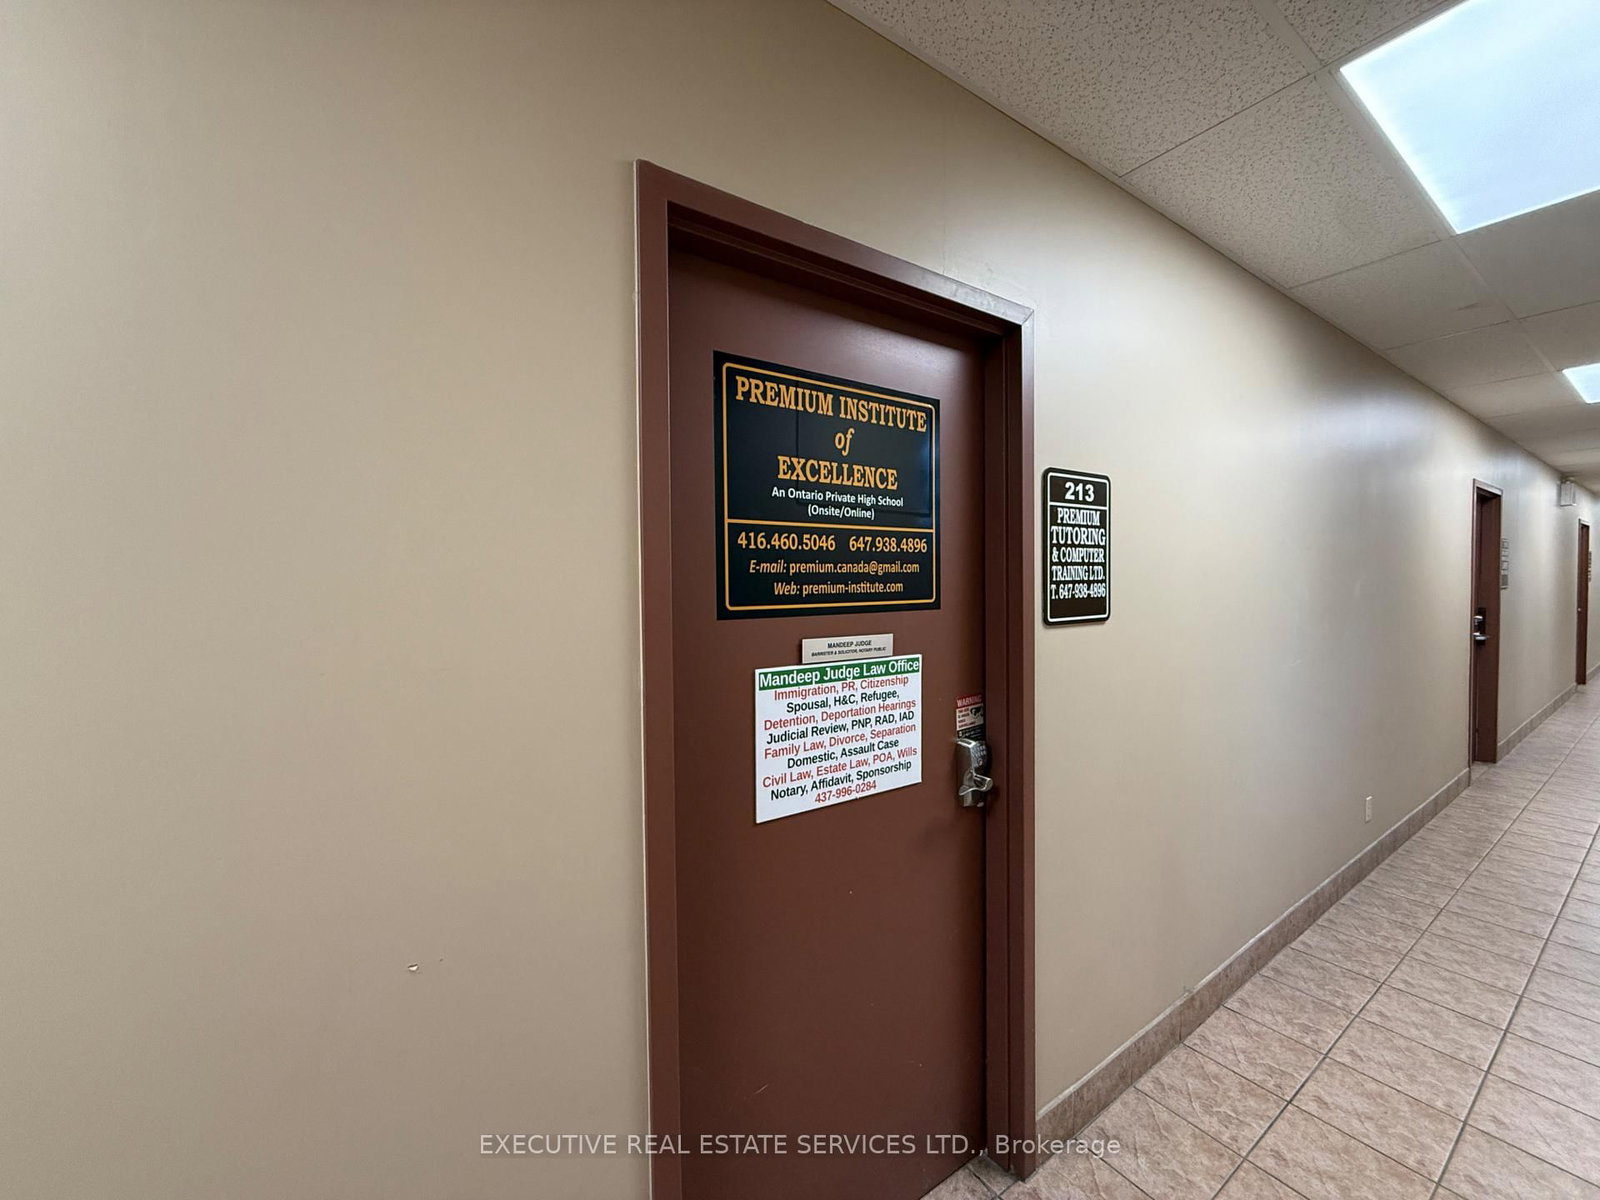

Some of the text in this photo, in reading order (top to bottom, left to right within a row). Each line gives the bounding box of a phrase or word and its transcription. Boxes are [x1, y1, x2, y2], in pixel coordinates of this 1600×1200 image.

[736, 376, 927, 432] PREMIUM INSTITUTE
[835, 428, 854, 456] of
[777, 456, 898, 490] EXCELLENCE
[772, 487, 904, 507] An Ontario Private High School
[1065, 482, 1094, 501] 213
[808, 504, 875, 520] (Onsite/Online)
[1057, 508, 1100, 526] PREMIUM
[737, 532, 927, 553] 416.460.5046 647.938.4896
[1051, 526, 1106, 545] TUTORING
[1052, 547, 1104, 562] & COMPUTER
[749, 560, 919, 576] E-mail: premium.canada@gmail.com
[1052, 566, 1105, 581] TRAINING LTD.
[774, 581, 903, 597] Web: premium-institute.com
[1051, 583, 1105, 599] T. 647-938-4896
[760, 660, 919, 688] Mandeep Judge Law Office
[774, 675, 908, 701] Immigration, PR, Citizenship
[787, 689, 899, 715] Spousal, H&C, Refugee,
[764, 699, 916, 730] Detention, Deportation Hearings
[767, 711, 914, 744] Judicial Review, PNP, RAD, IAD
[765, 724, 916, 759] Family Law, Divorce, Separation
[788, 739, 899, 769] Domestic, Assault Case
[763, 747, 917, 788] Civil Law, Estate Law, POA, Wills
[771, 759, 911, 801] Notary, Affidavit, Sponsorship
[815, 780, 877, 803] 437-996-0284
